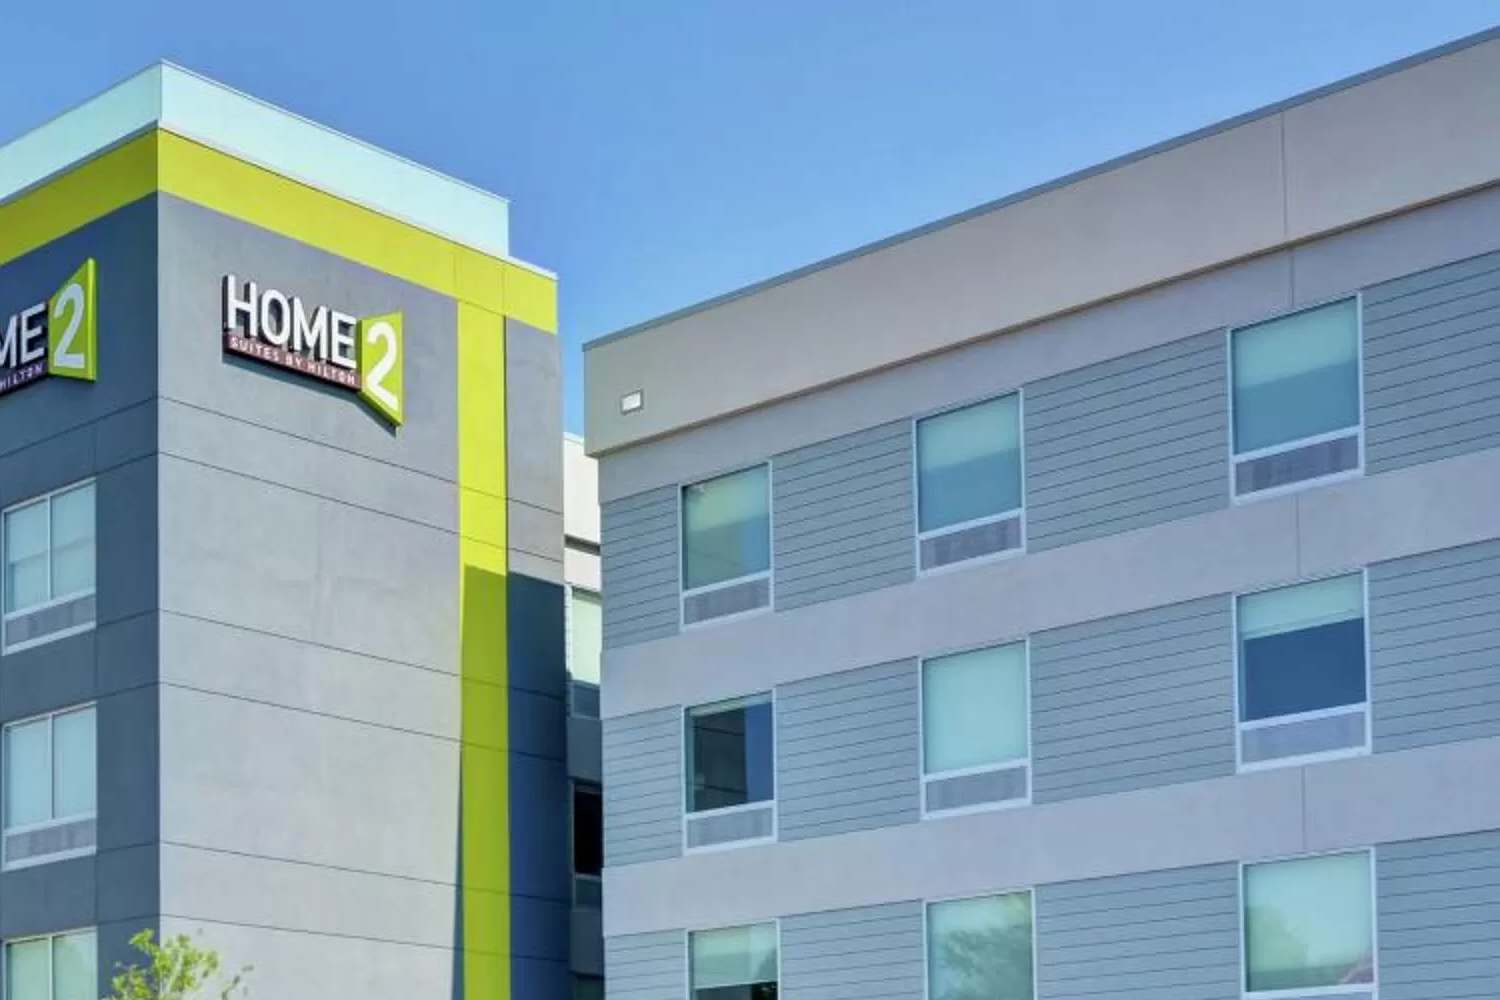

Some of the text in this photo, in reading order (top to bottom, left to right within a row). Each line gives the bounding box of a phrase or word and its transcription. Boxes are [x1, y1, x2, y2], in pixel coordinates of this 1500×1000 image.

[53, 283, 85, 369] 2
[226, 274, 399, 409] HOME 2
[0, 363, 45, 392] HILTON
[230, 336, 356, 386] SUITES BY HILTON
